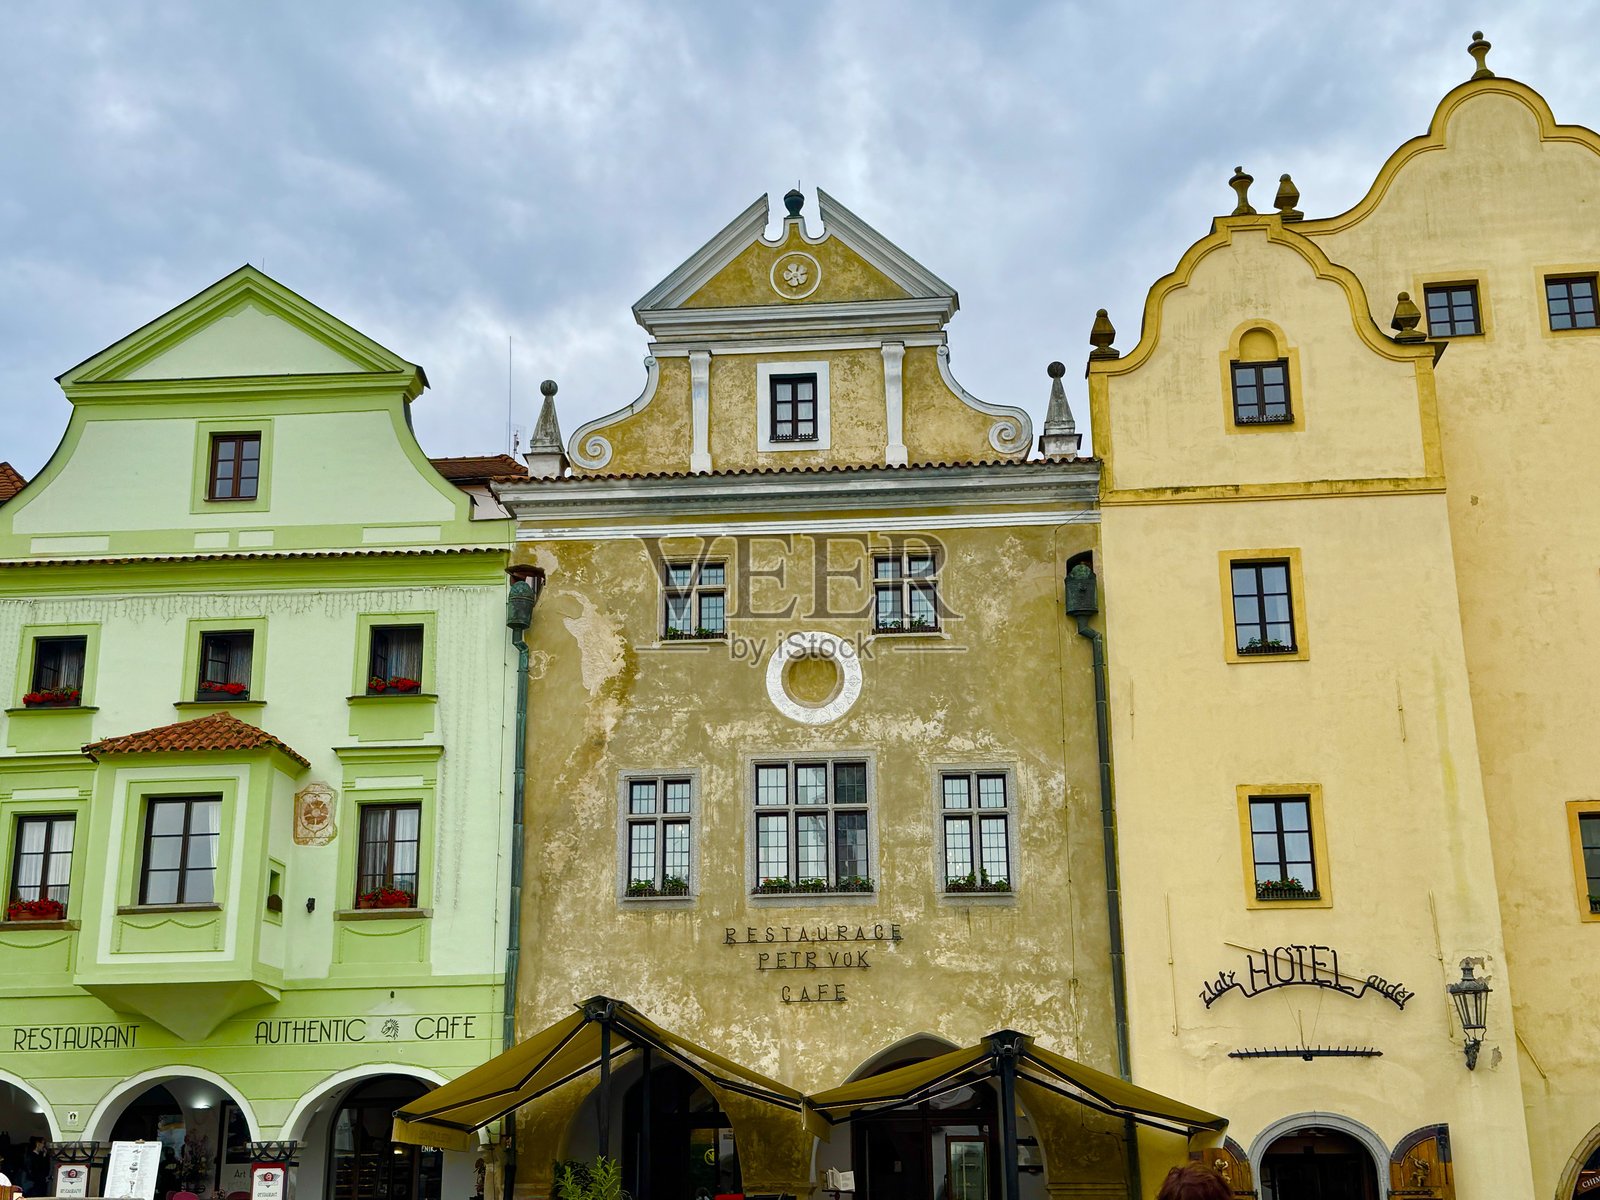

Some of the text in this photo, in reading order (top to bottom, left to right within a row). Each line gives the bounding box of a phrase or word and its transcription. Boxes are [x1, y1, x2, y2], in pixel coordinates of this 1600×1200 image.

[725, 924, 902, 945] RESTAURACE
[758, 950, 870, 970] PETR VOK
[1247, 944, 1354, 992] HOTEL
[781, 984, 847, 1002] CAFE
[14, 1025, 140, 1050] RESTAURANT
[255, 1016, 477, 1044] AUTHENTIC CAFE
